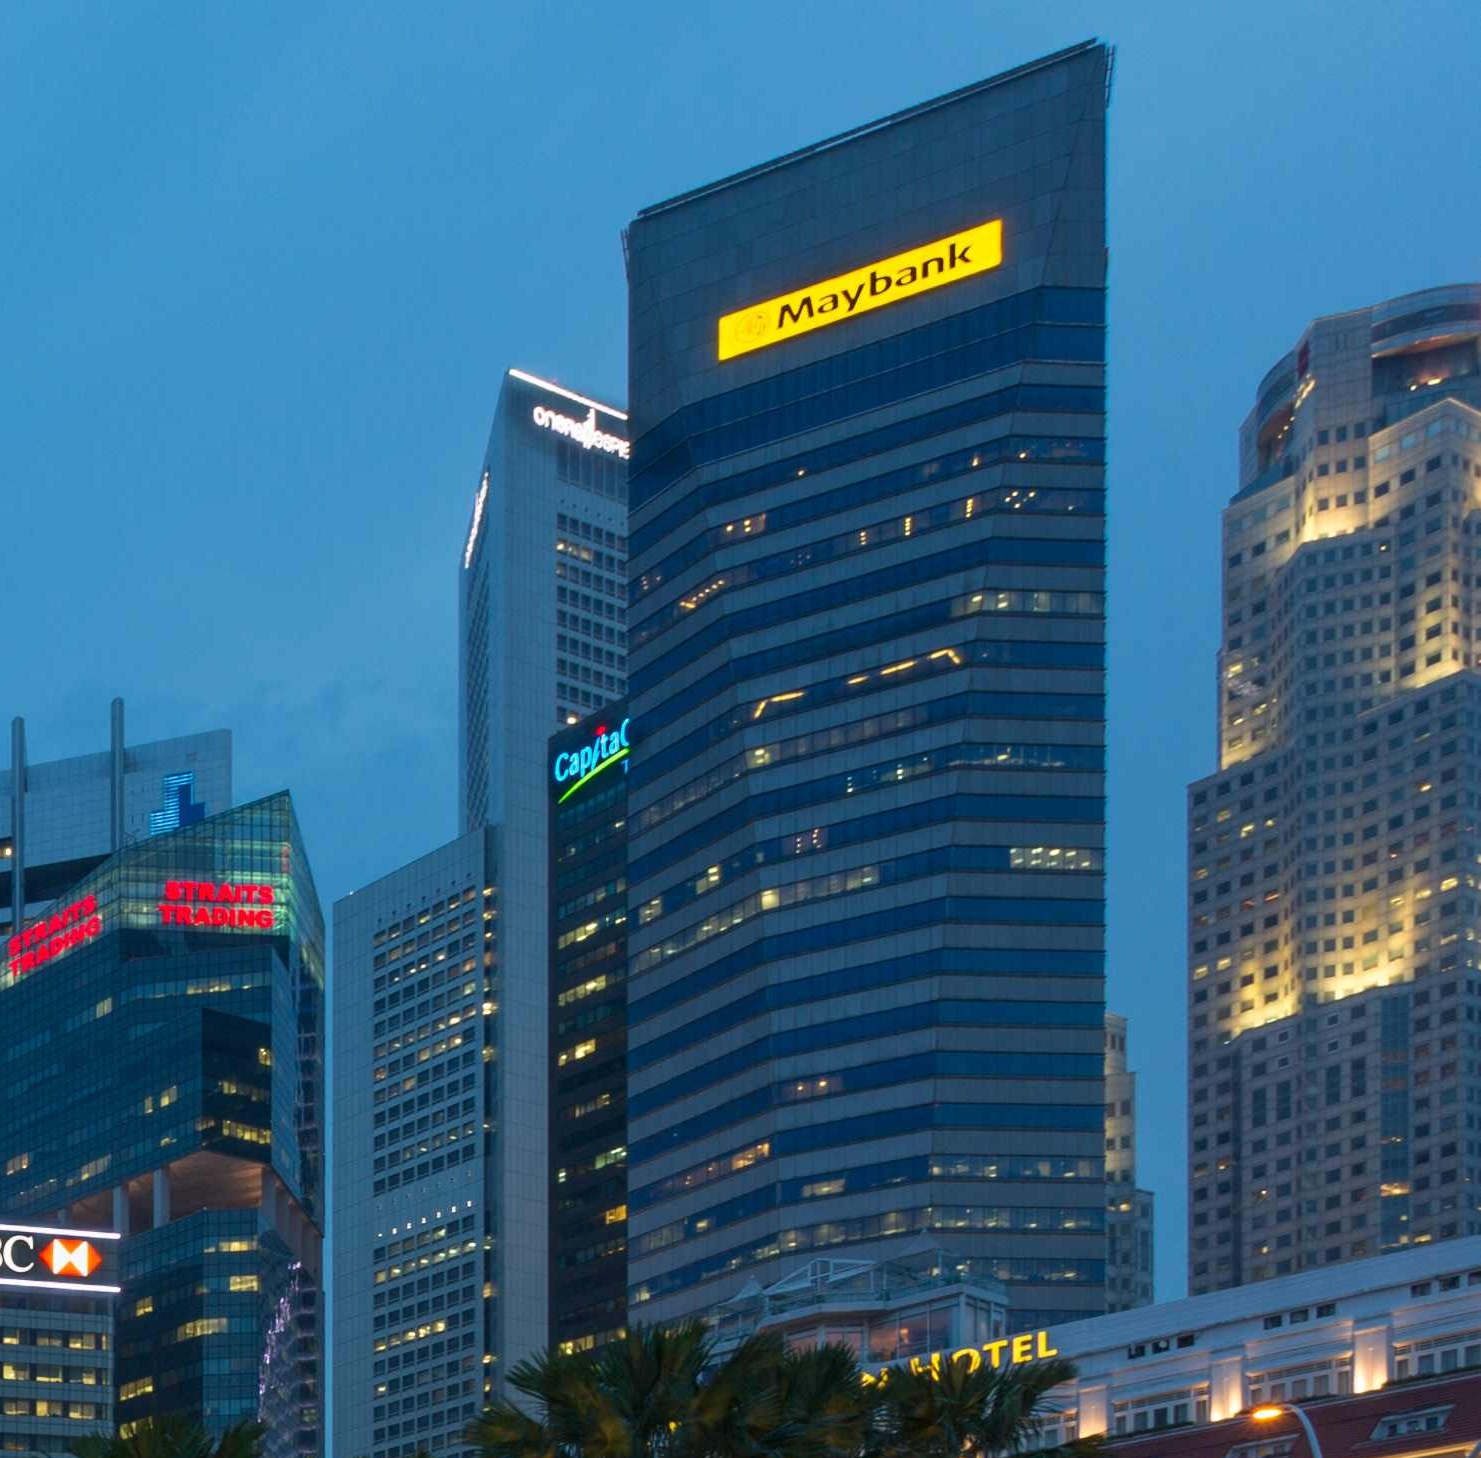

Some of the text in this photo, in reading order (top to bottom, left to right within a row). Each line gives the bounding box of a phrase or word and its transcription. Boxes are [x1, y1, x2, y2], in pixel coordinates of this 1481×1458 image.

[776, 242, 973, 329] Maybank
[157, 904, 275, 929] TRADING
[164, 879, 275, 905] STRAITS
[7, 894, 97, 956] STRAITS
[7, 914, 103, 977] TRADING
[909, 1330, 1059, 1382] HOTEL
